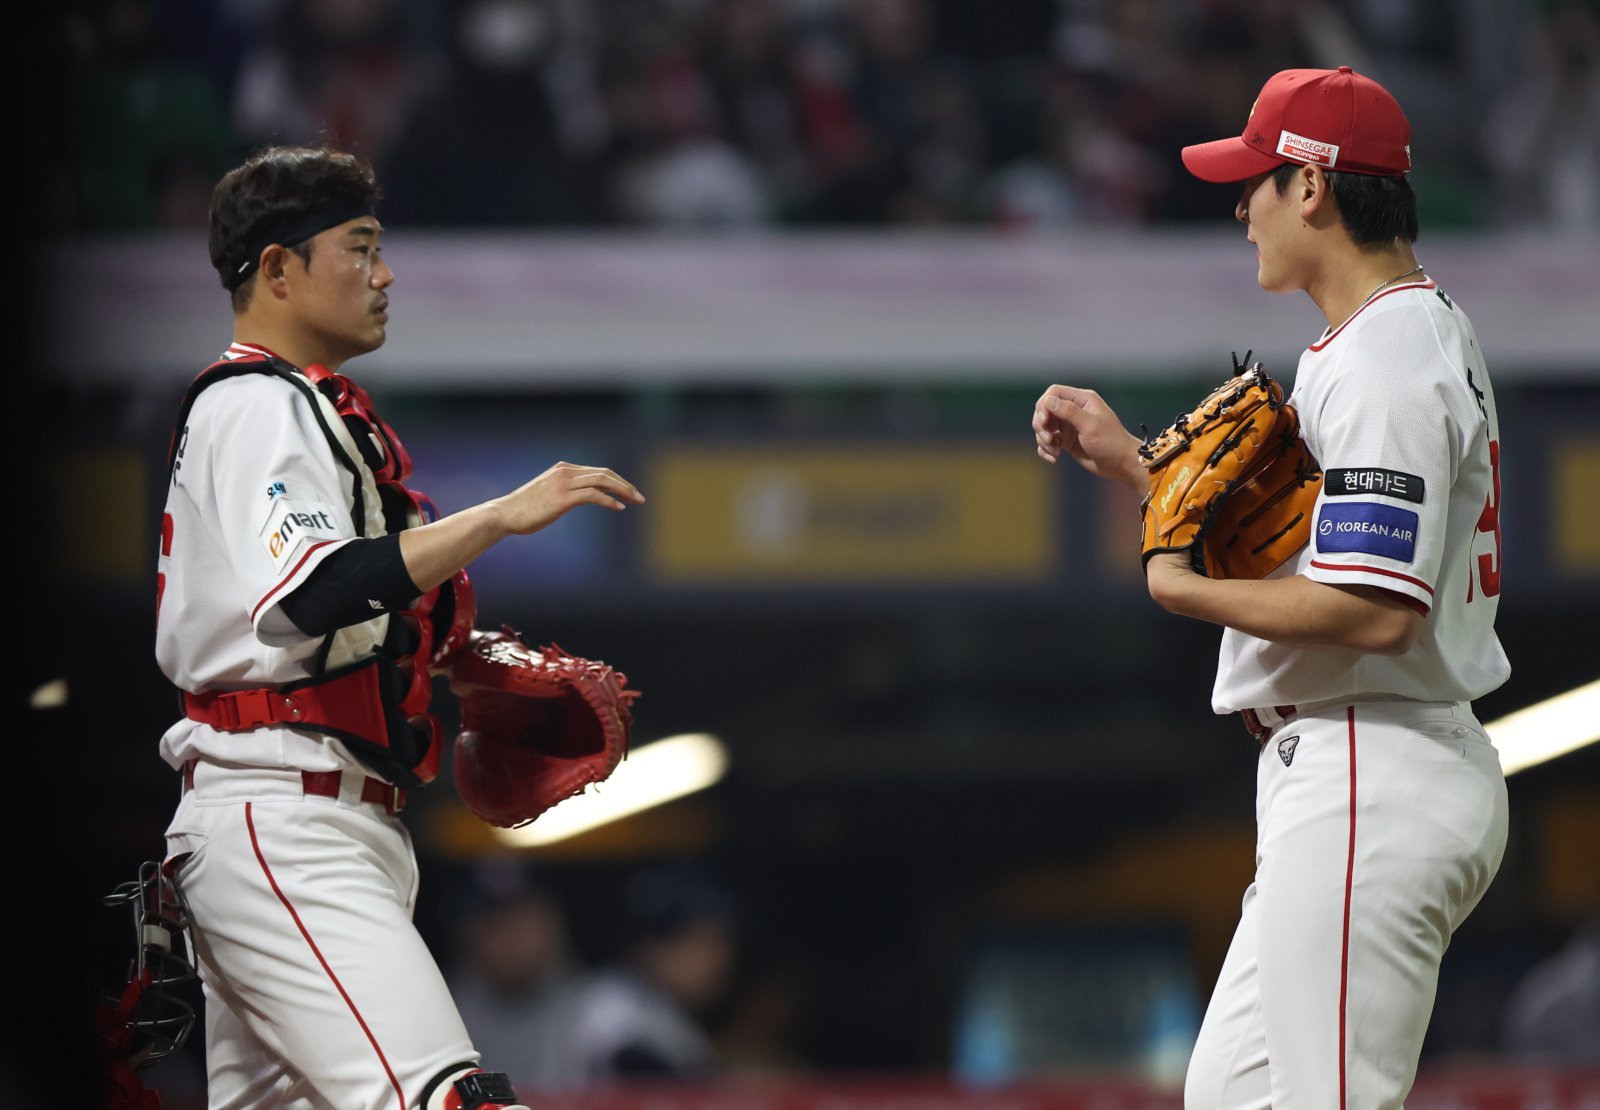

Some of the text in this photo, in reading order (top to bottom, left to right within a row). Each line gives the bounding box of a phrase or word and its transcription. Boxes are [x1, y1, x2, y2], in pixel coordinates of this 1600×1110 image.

[1285, 135, 1333, 155] SHINSEGAE
[1291, 148, 1320, 160] SHOPPING
[1344, 471, 1407, 493] 현대카드
[269, 511, 335, 558] emart
[1336, 522, 1413, 542] KOREAN AIR
